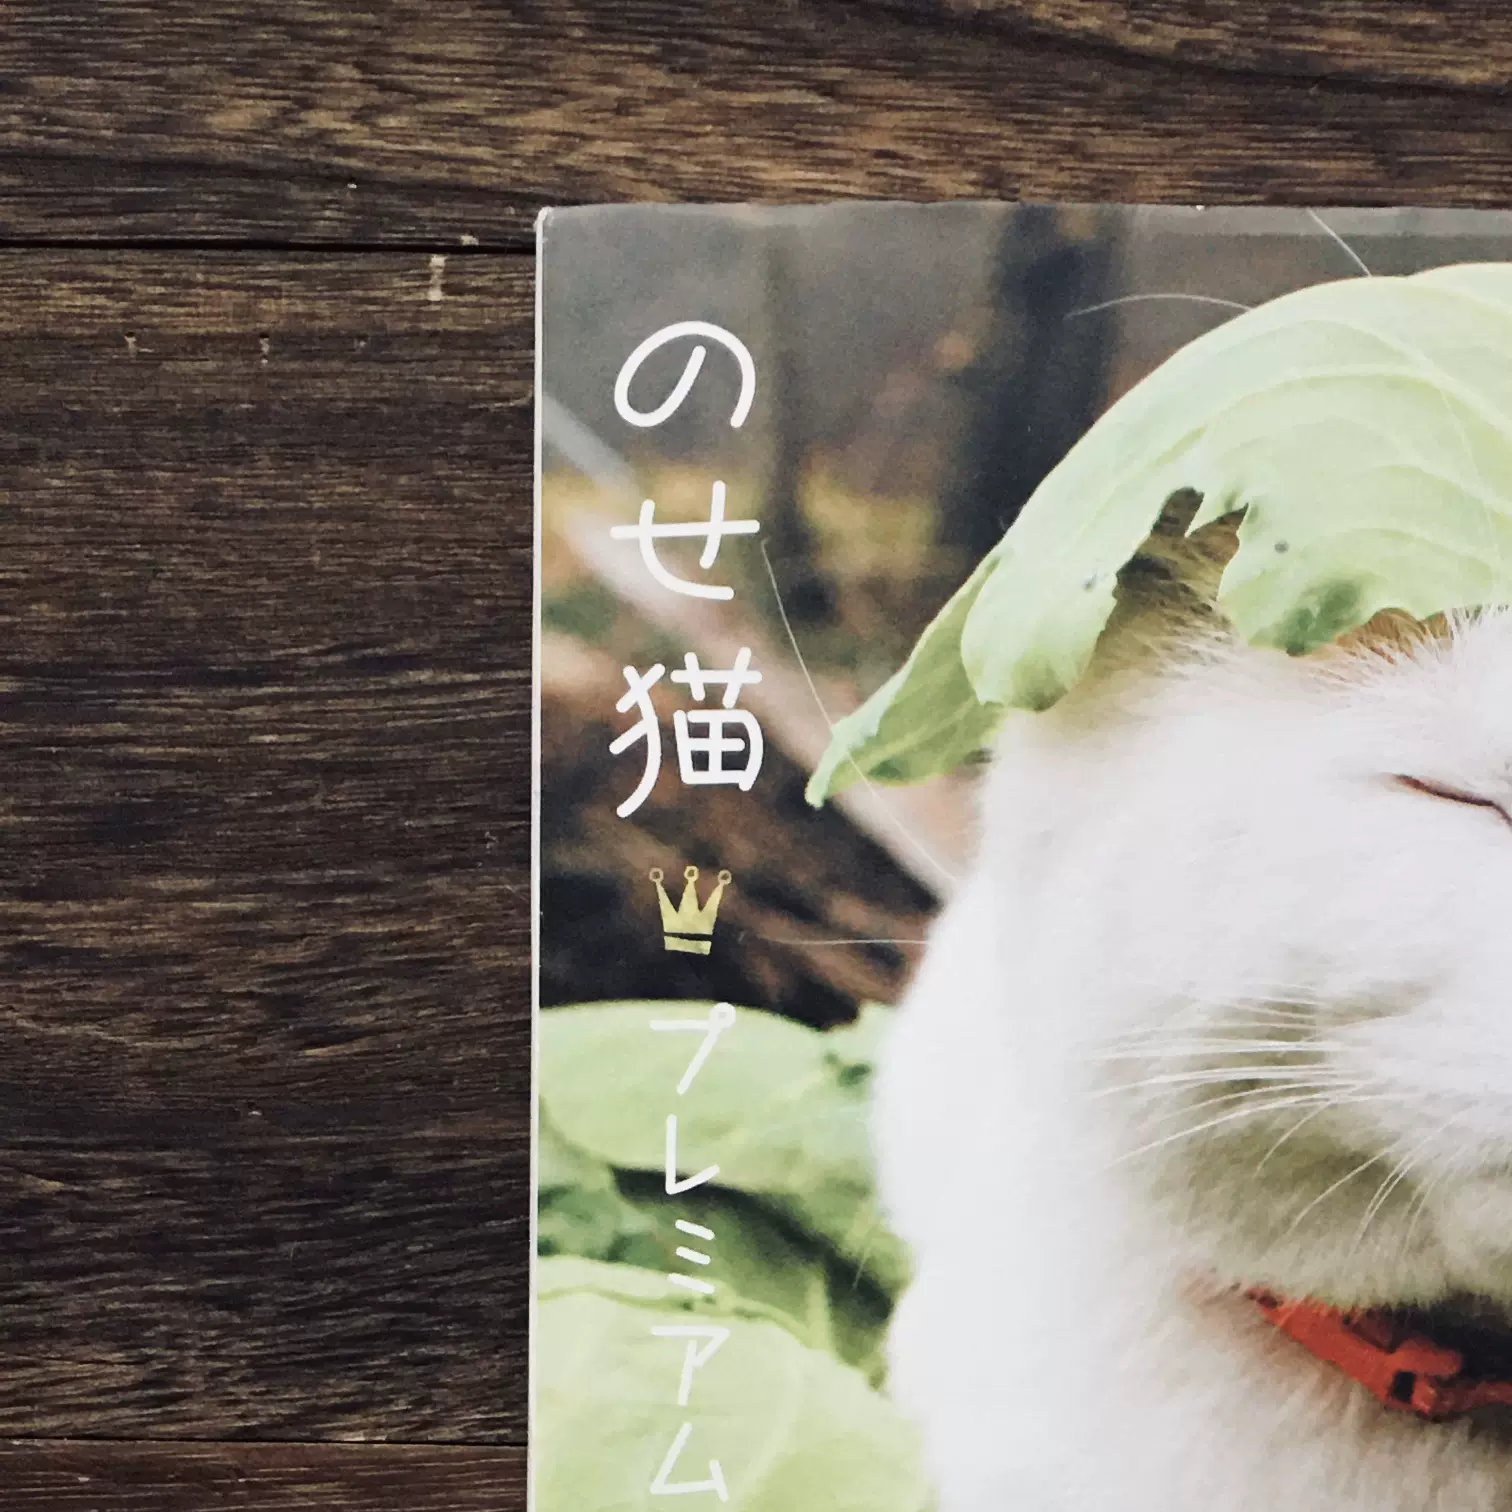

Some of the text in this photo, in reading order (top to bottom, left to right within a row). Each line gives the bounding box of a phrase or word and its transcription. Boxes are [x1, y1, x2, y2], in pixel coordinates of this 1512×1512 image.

[609, 320, 763, 818] のせ猫
[650, 1002, 736, 1501] プレミアム
